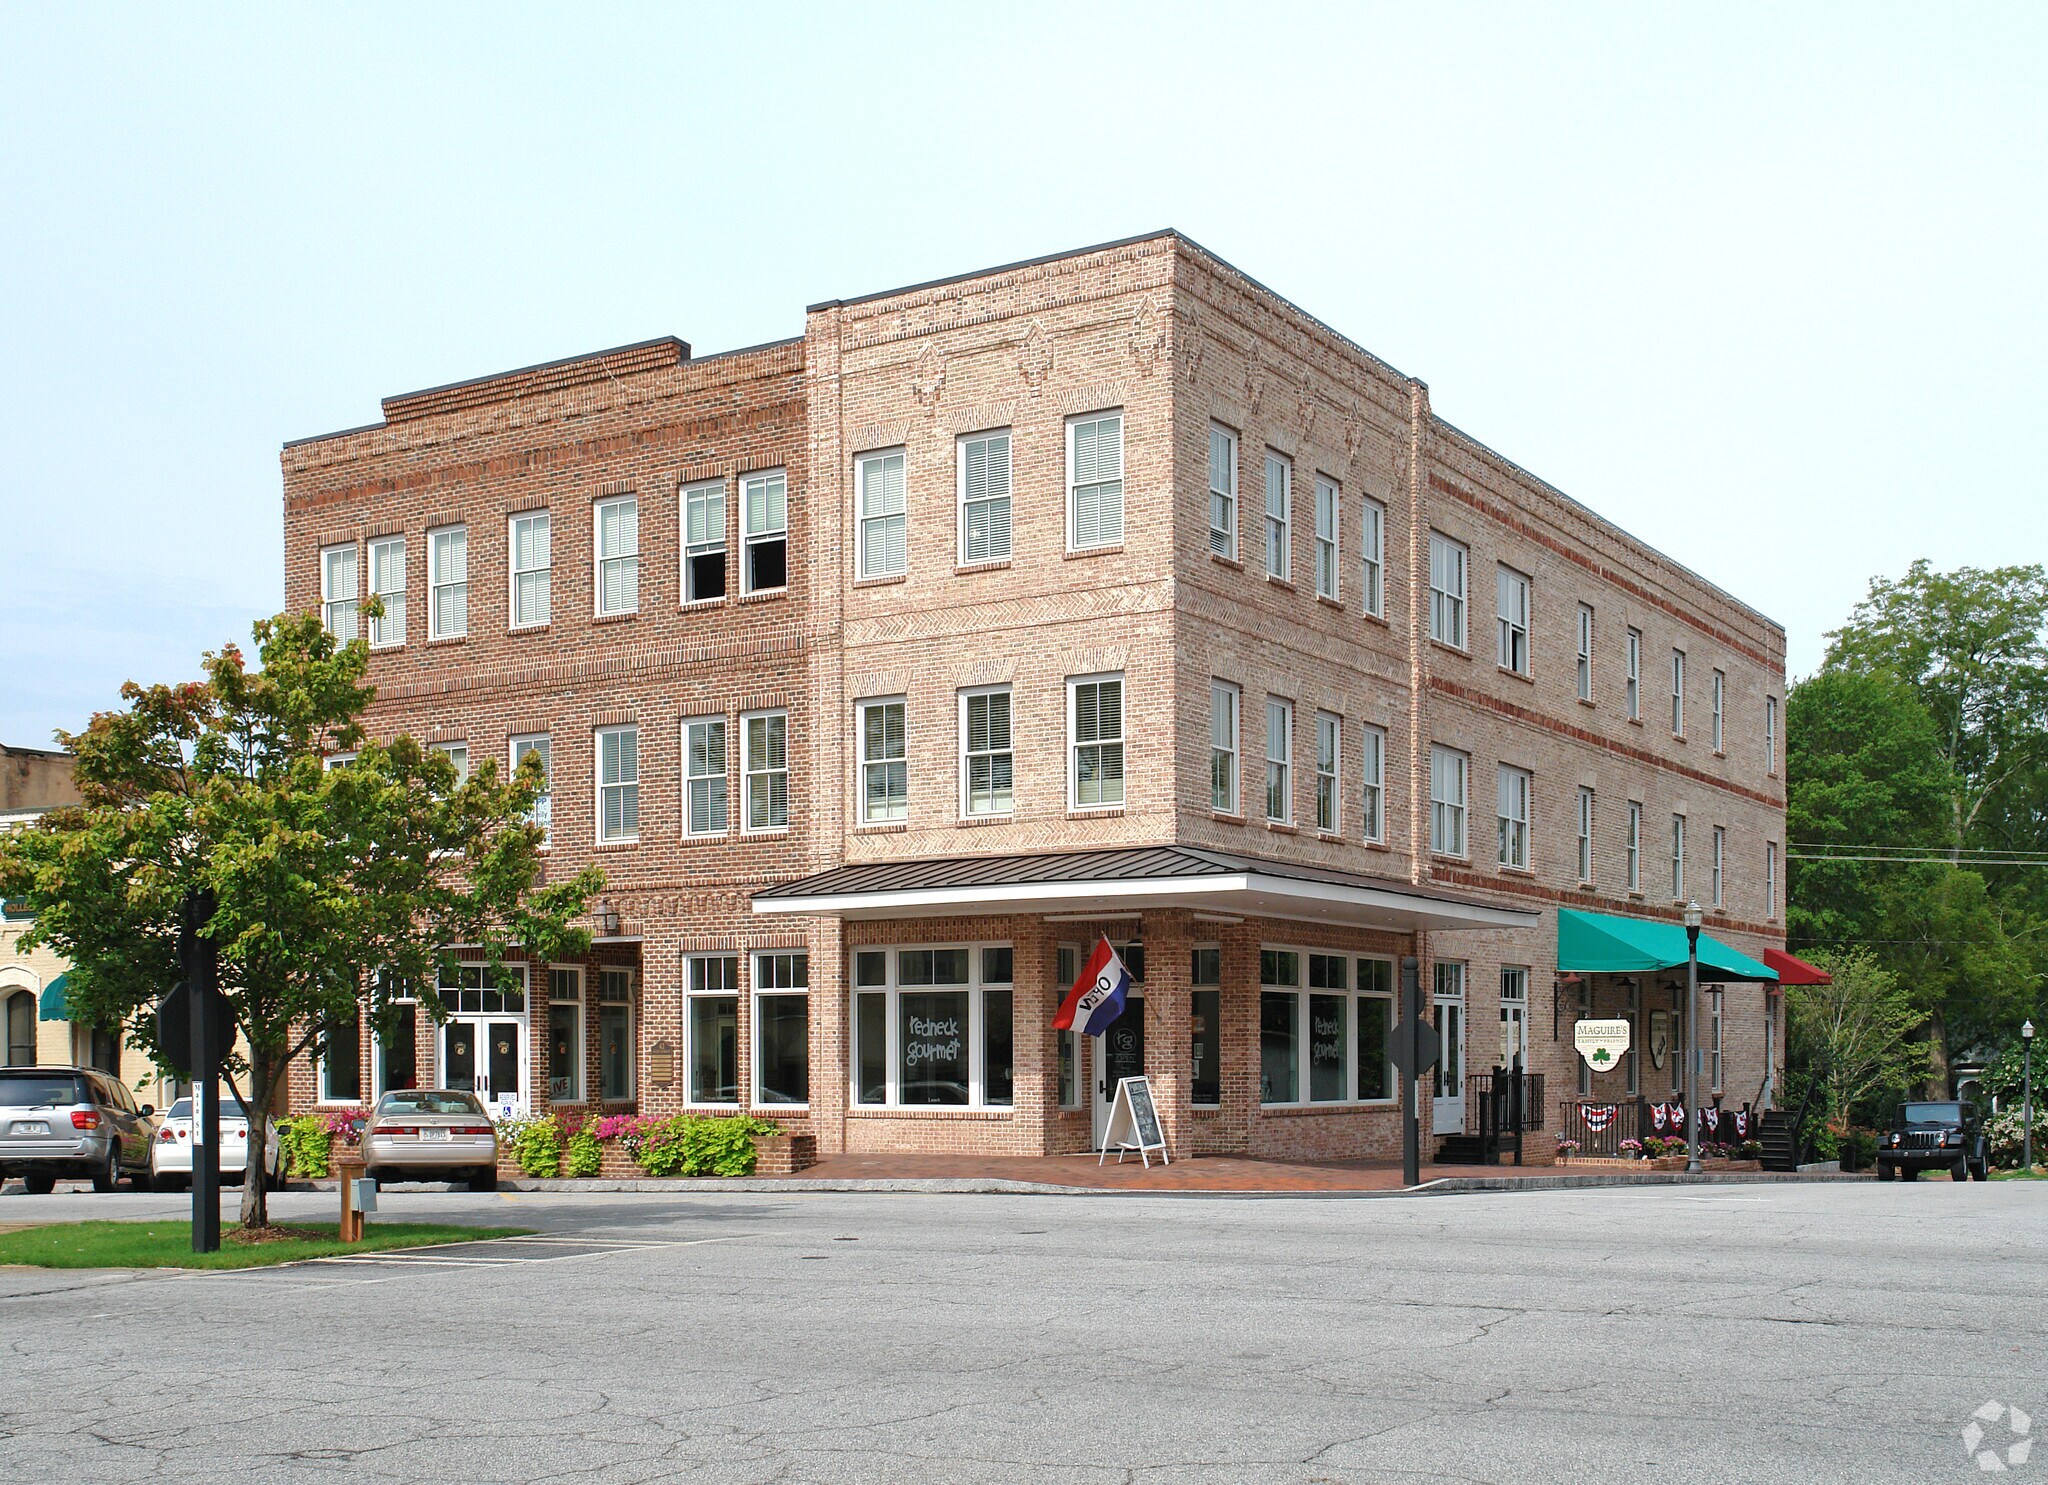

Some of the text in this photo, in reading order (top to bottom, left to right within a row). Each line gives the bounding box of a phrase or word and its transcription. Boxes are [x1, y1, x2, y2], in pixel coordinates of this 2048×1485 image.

[909, 1016, 959, 1037] redneck
[1577, 1025, 1628, 1035] MAGUIRE'S
[906, 1038, 961, 1066] gourmet
[195, 1121, 200, 1136] St
